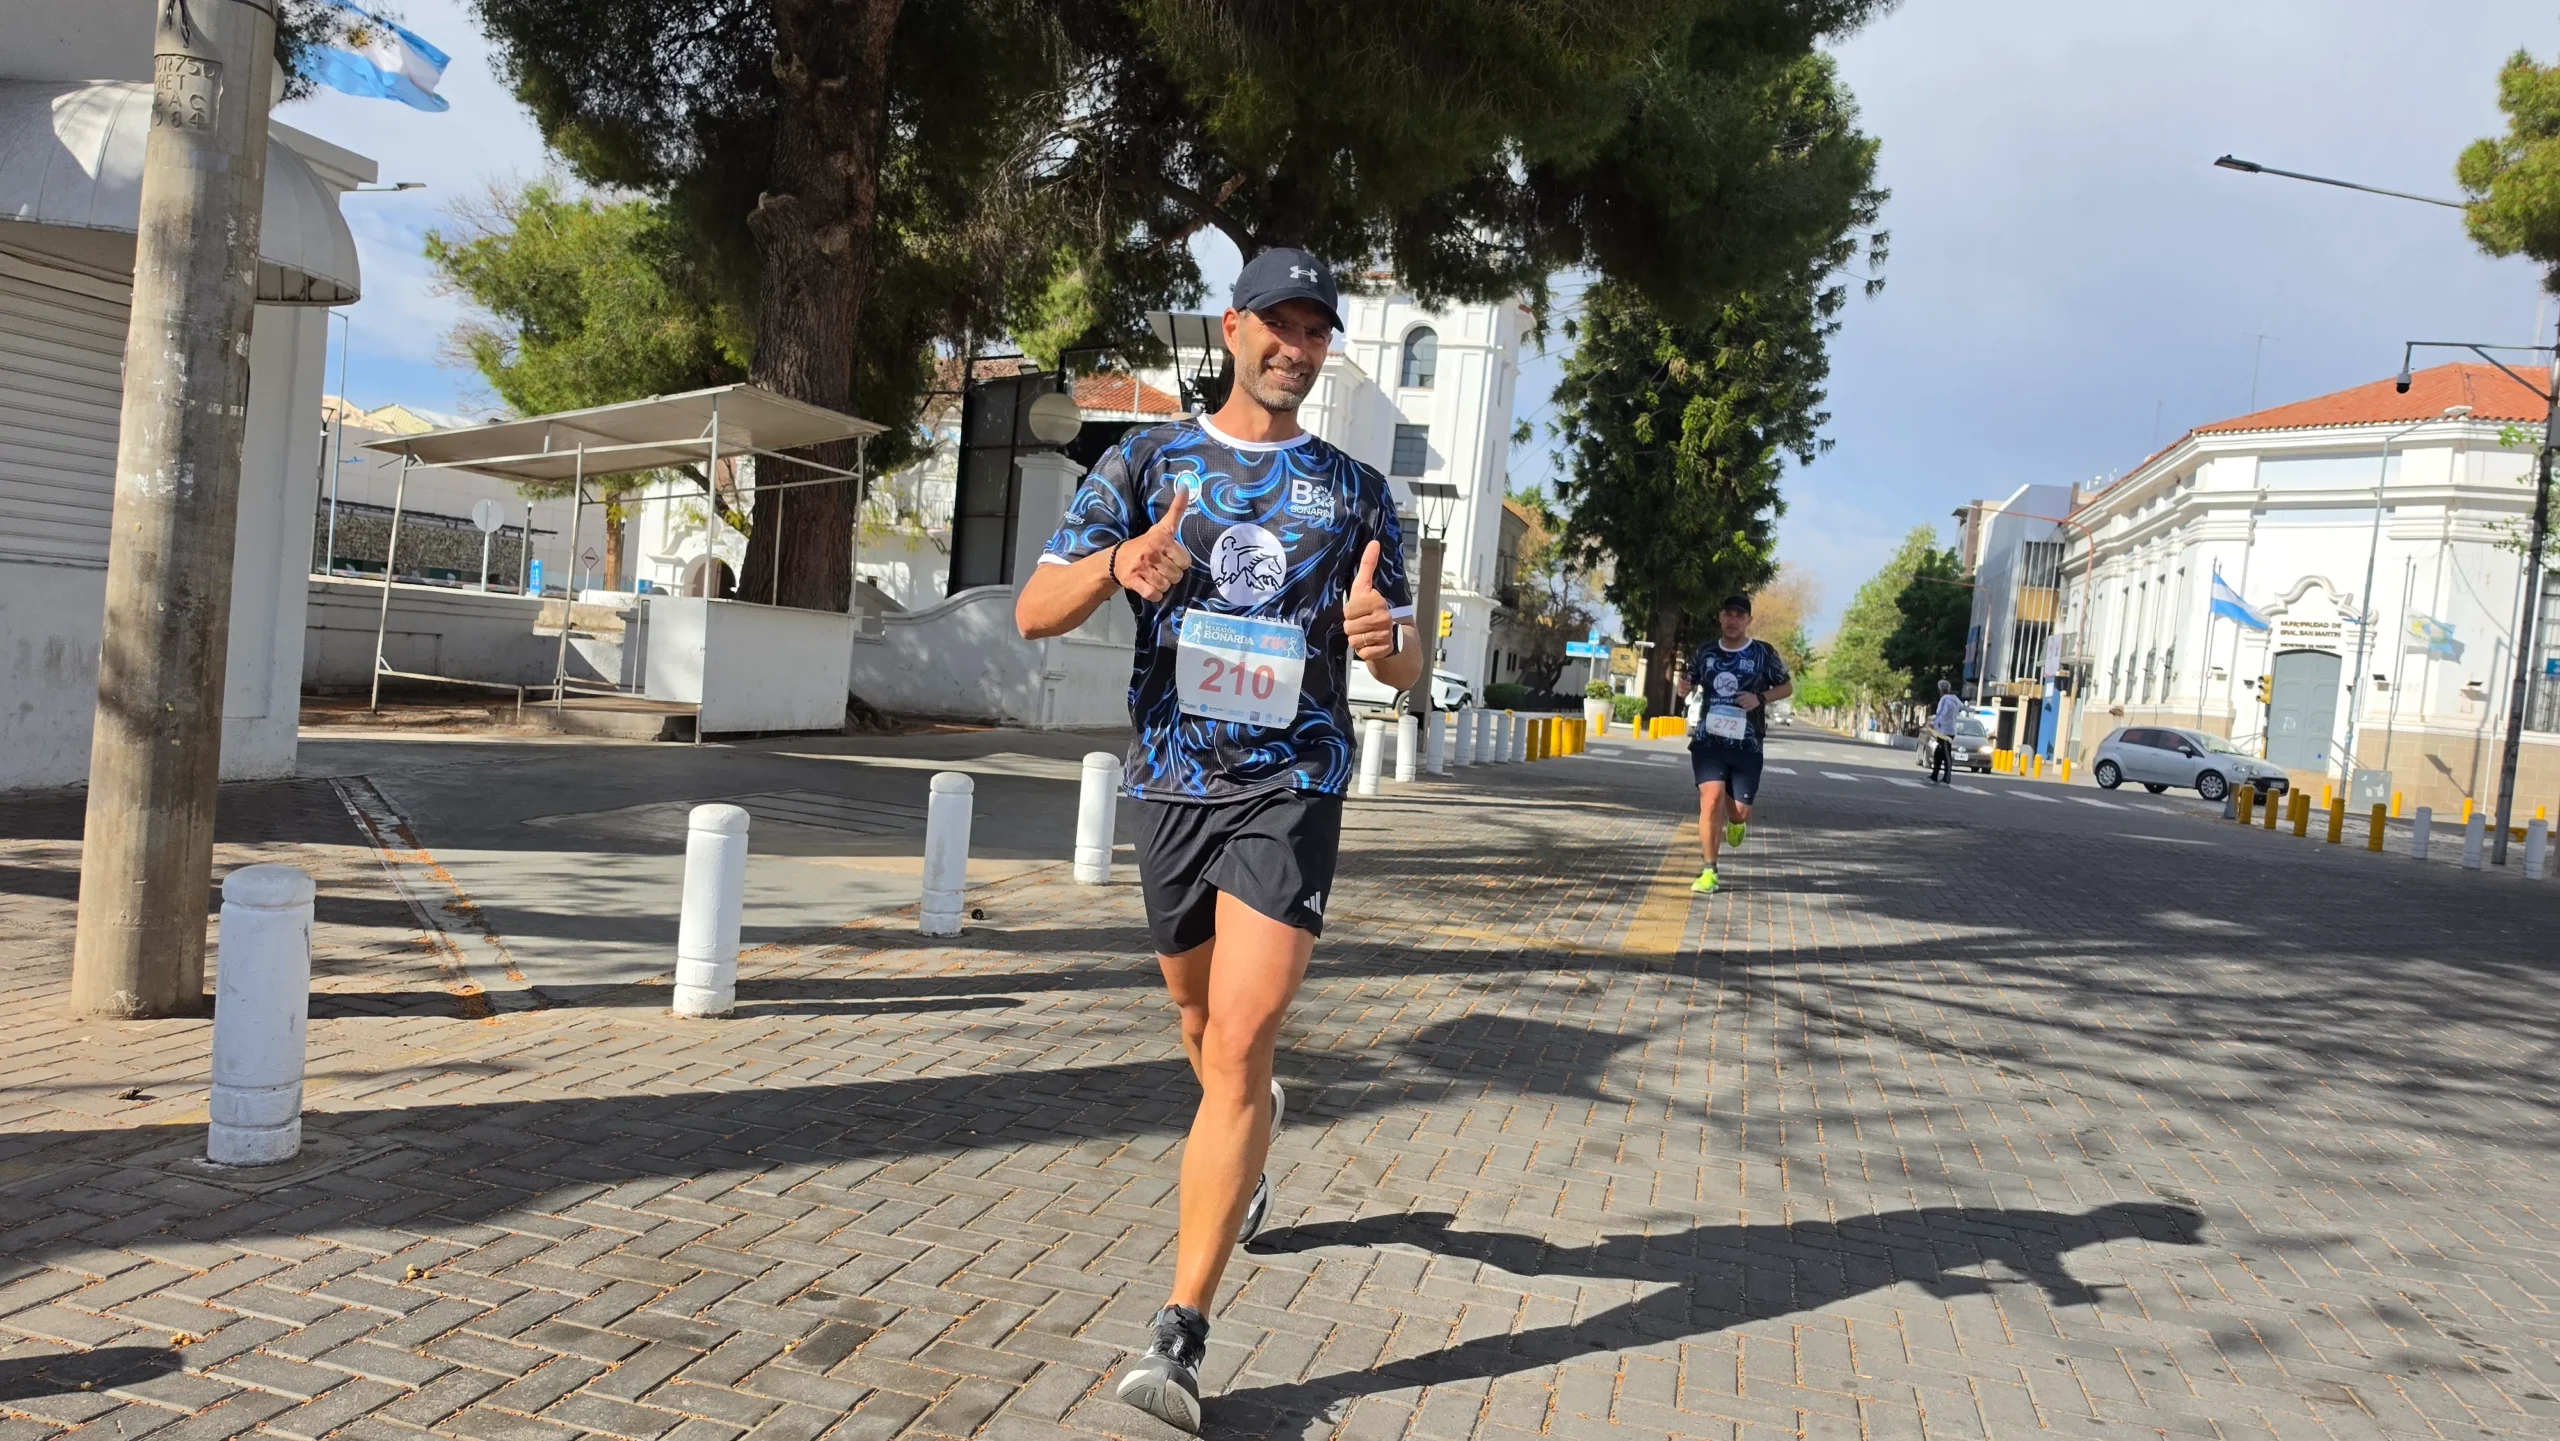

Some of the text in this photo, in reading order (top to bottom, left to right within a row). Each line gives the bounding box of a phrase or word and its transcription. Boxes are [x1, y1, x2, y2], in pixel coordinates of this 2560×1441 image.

[1204, 631, 1254, 646] BONARDA
[1198, 657, 1275, 699] 210
[1713, 717, 1738, 731] 272
